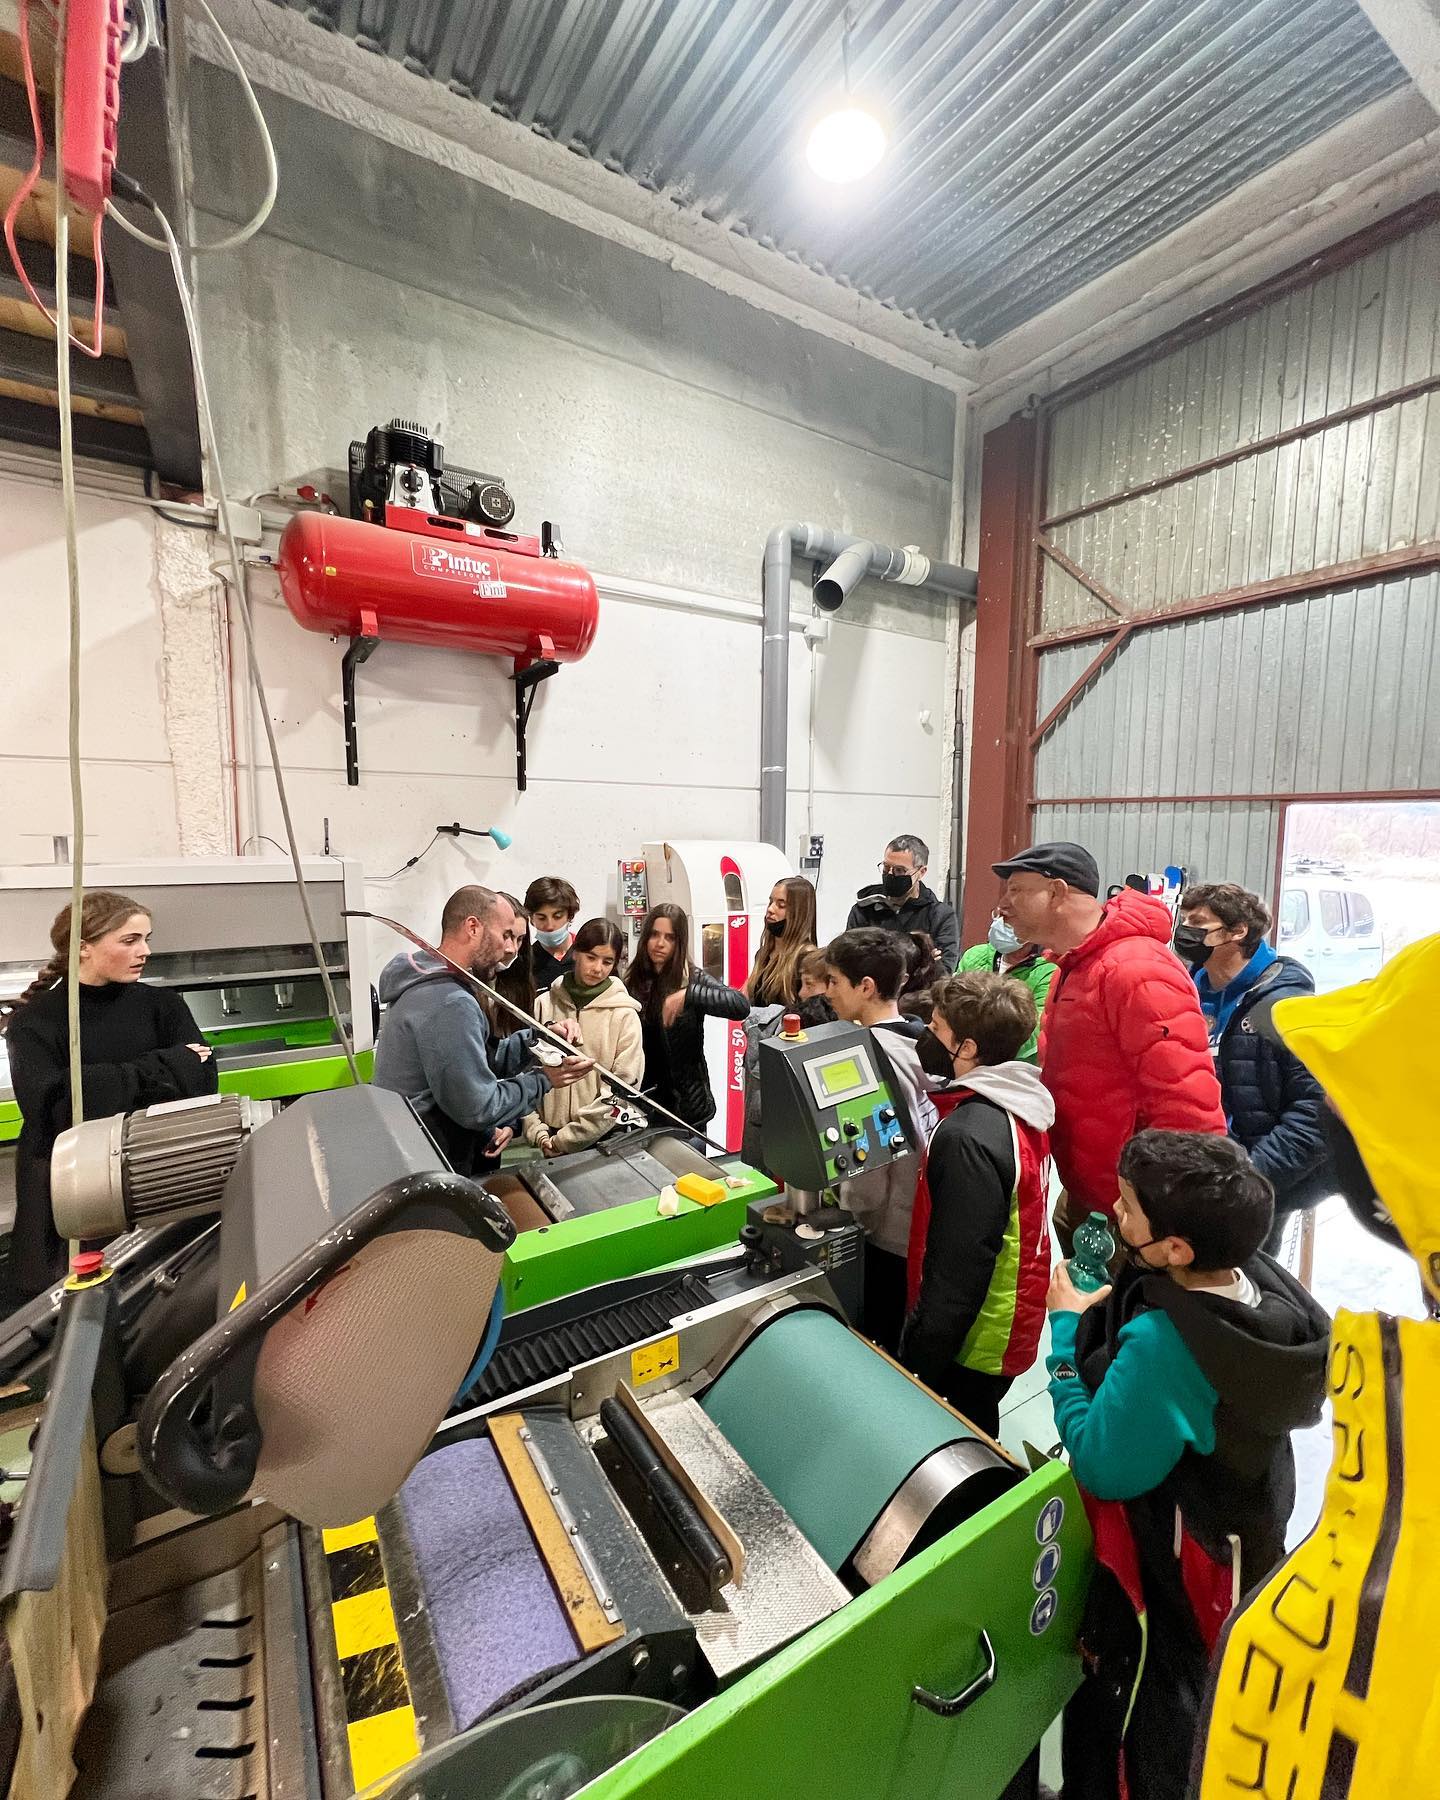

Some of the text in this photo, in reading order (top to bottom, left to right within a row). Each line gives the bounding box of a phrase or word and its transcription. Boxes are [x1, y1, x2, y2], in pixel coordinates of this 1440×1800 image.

[422, 547, 491, 576] Pintuc
[482, 585, 505, 596] Fini
[730, 1028, 745, 1091] Laser 50
